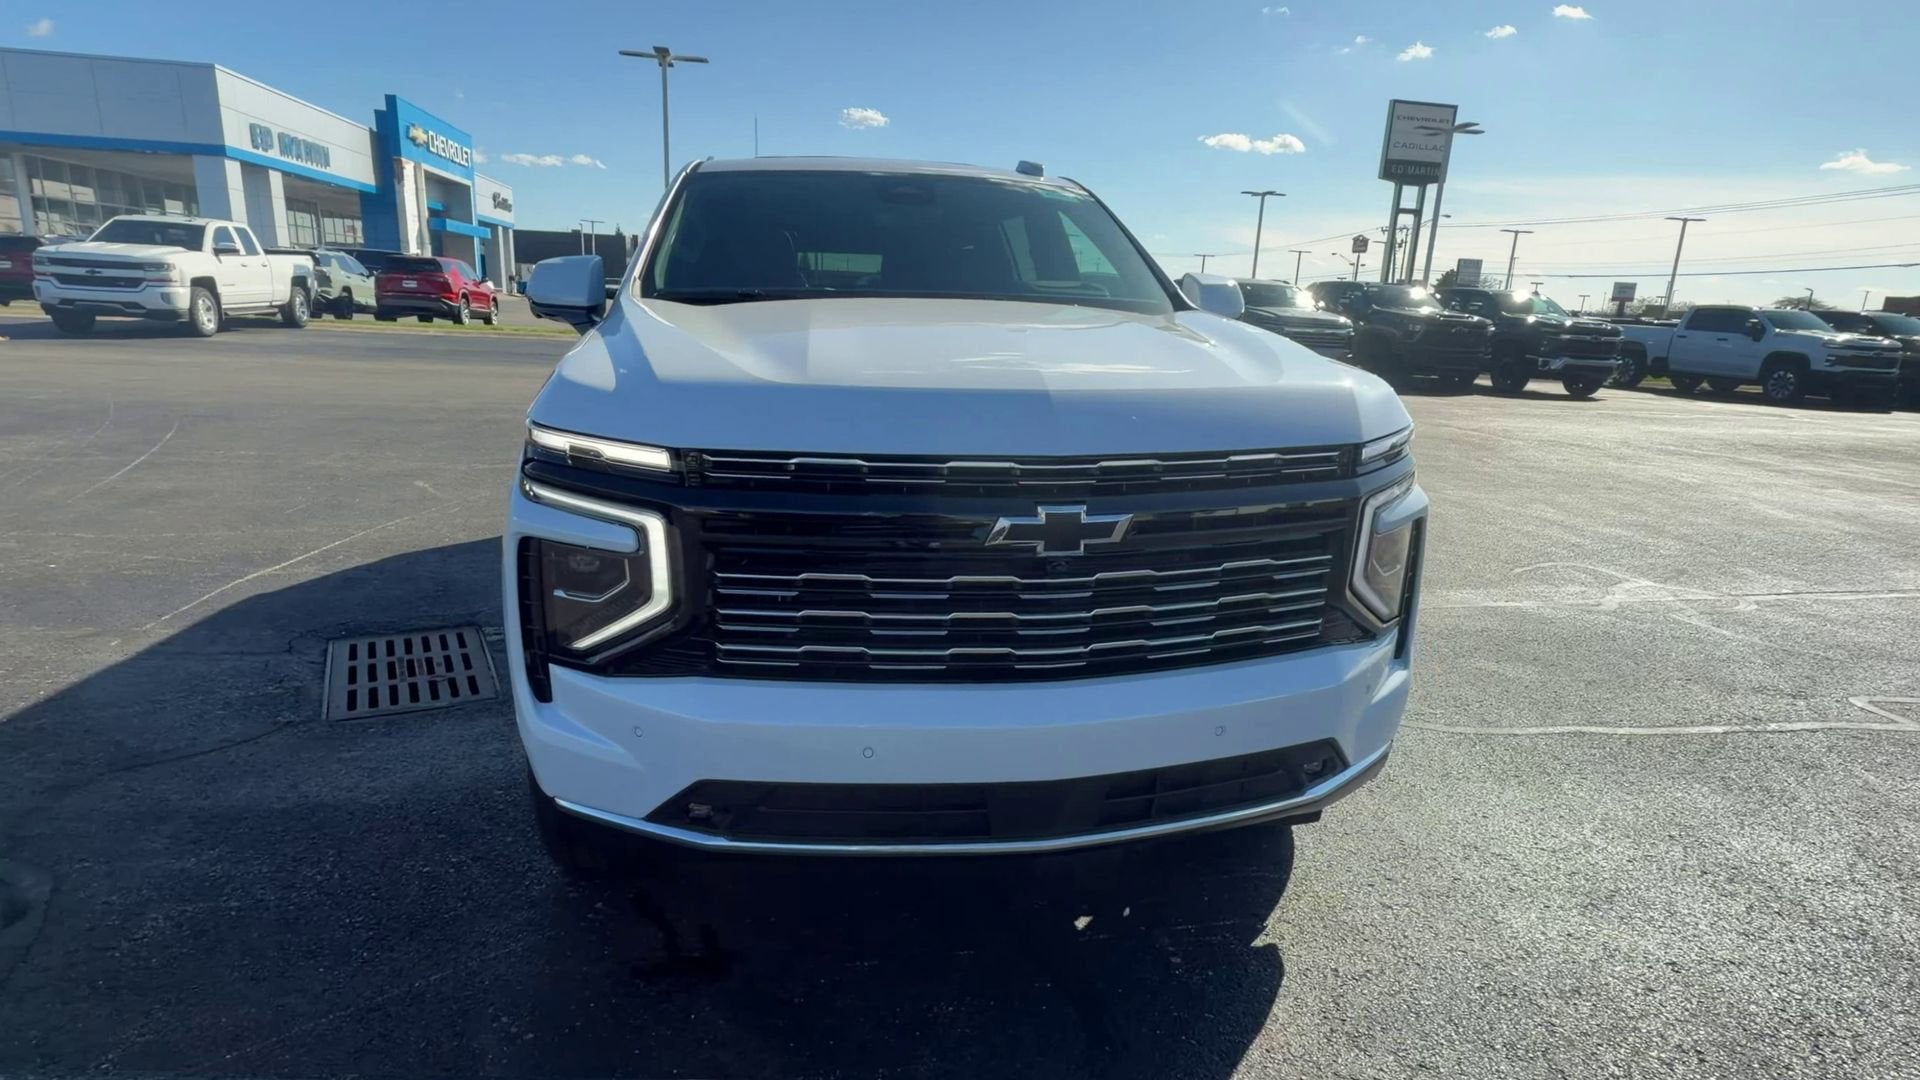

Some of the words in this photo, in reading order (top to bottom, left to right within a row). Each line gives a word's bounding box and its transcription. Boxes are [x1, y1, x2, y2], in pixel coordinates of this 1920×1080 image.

[1396, 114, 1450, 124] CHEVROLET
[428, 130, 471, 168] CHEVROLET
[1393, 141, 1446, 152] CADILLAC
[1391, 164, 1404, 174] ED
